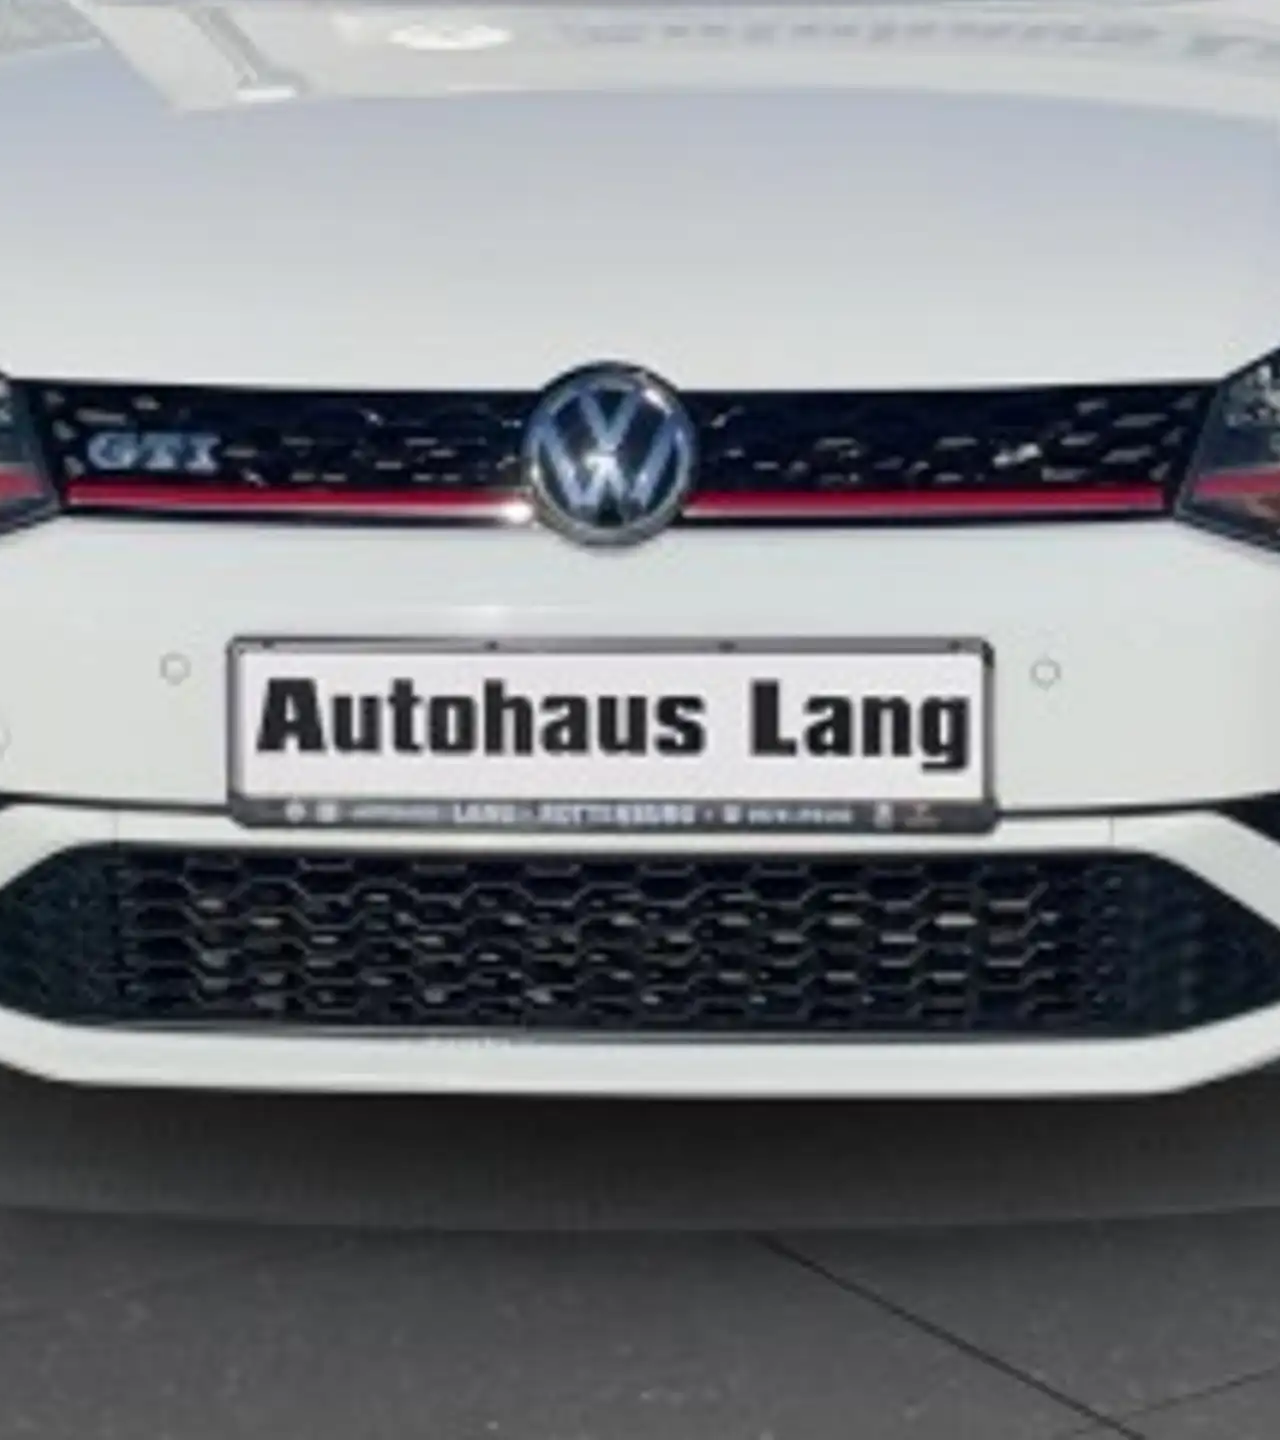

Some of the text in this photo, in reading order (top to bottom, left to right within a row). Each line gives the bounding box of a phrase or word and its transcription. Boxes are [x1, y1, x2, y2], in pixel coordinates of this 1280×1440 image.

[87, 432, 221, 475] GTI
[256, 676, 970, 774] Autohaus Lang
